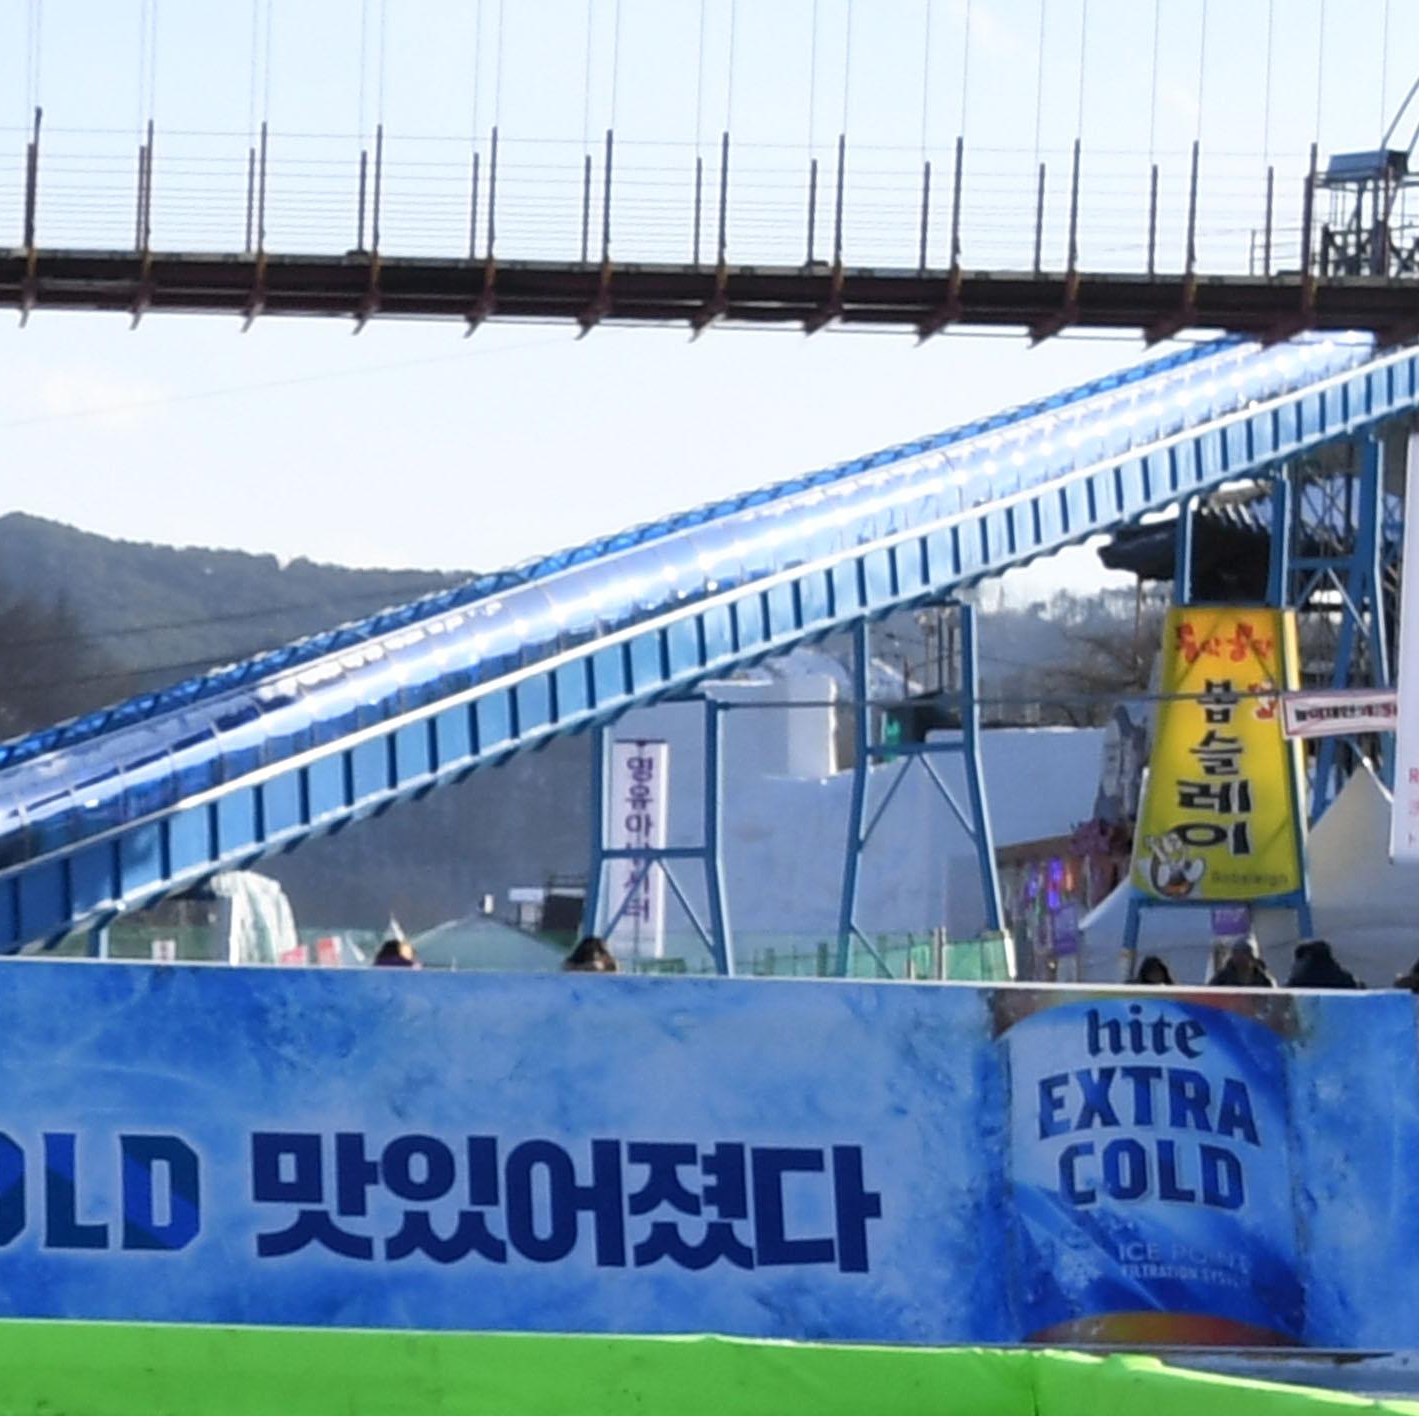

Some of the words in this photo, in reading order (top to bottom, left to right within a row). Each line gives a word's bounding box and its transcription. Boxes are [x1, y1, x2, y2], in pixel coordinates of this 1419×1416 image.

[1175, 679, 1253, 856] 봅슬레이
[1087, 1004, 1206, 1059] hite
[1039, 1065, 1261, 1147] EXTRA
[251, 1132, 882, 1273] 맛있어졌다
[1059, 1139, 1245, 1211] COLD
[1118, 1242, 1162, 1262] ICE
